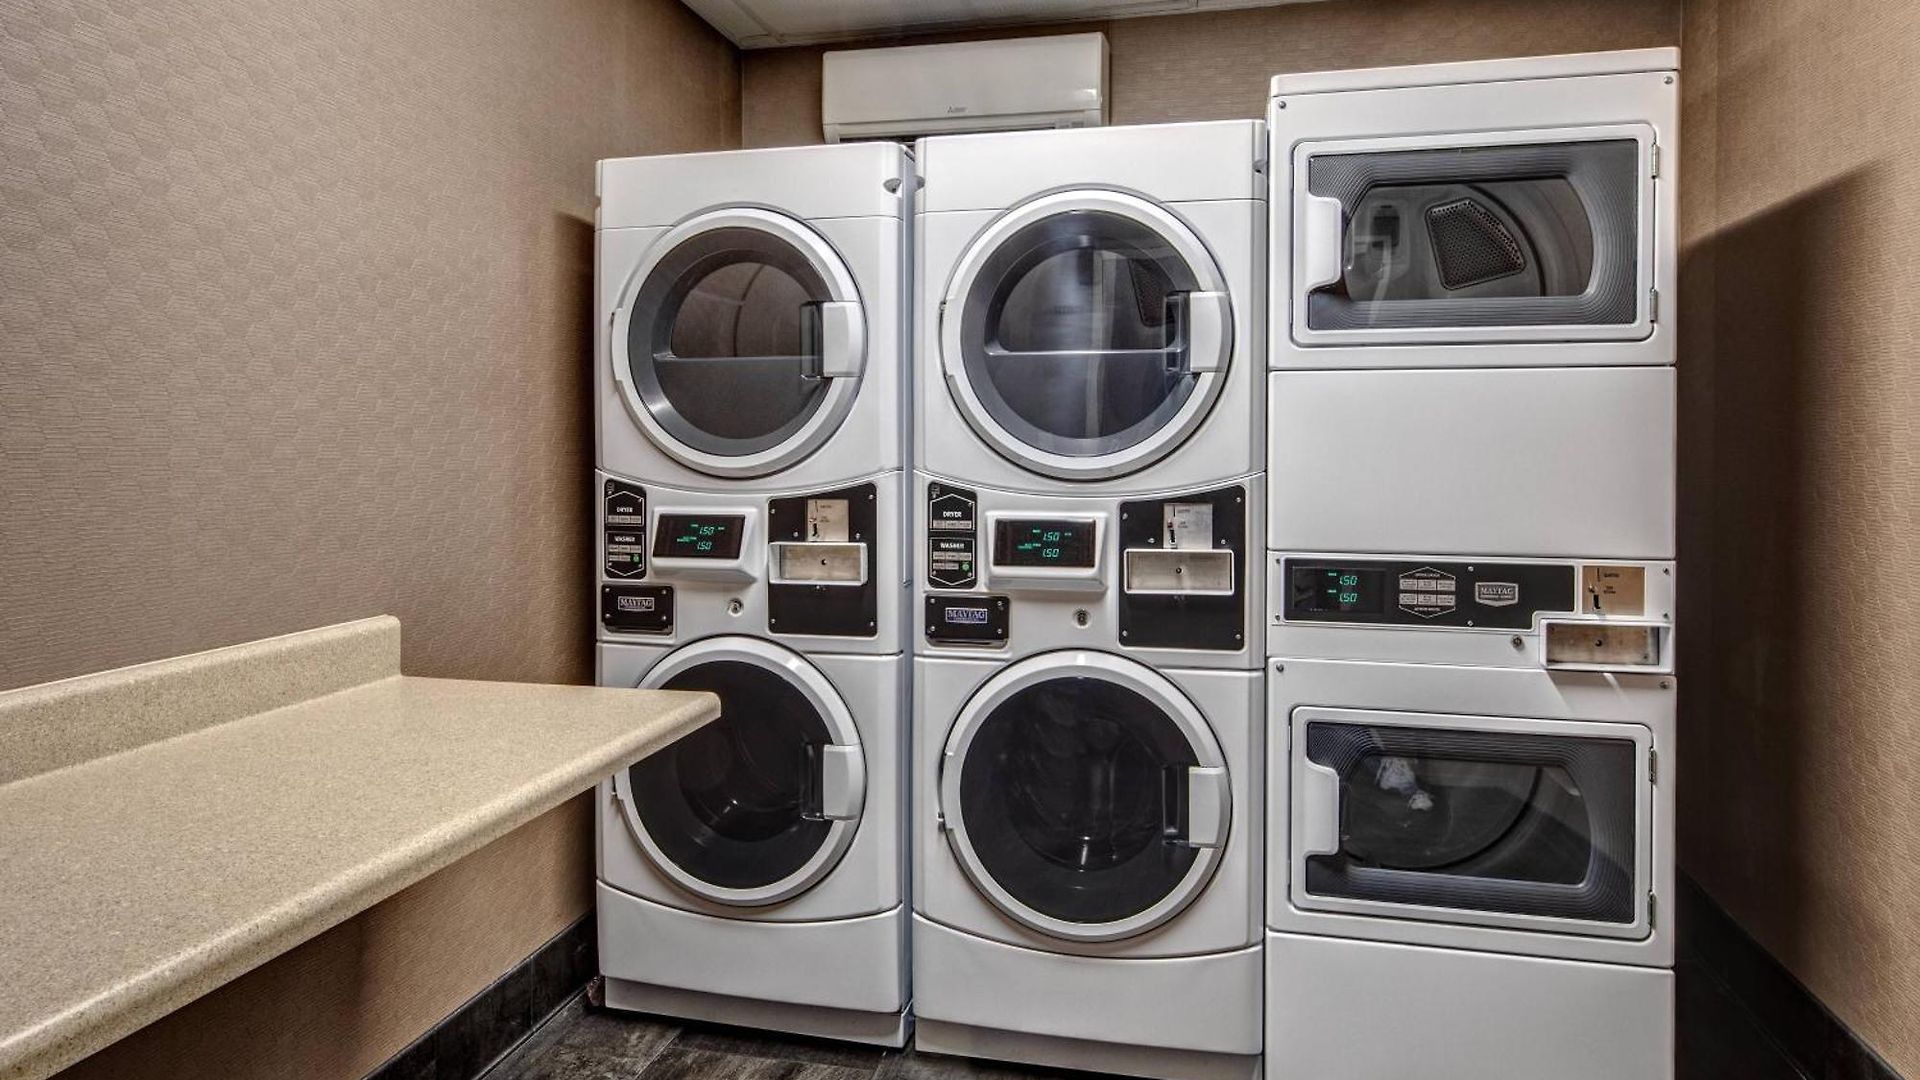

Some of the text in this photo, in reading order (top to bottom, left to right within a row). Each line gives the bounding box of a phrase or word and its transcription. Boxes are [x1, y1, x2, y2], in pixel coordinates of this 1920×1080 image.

[1481, 587, 1514, 595] MAYTAG
[620, 598, 653, 607] MAYTAG
[947, 609, 985, 619] MAYTAG
